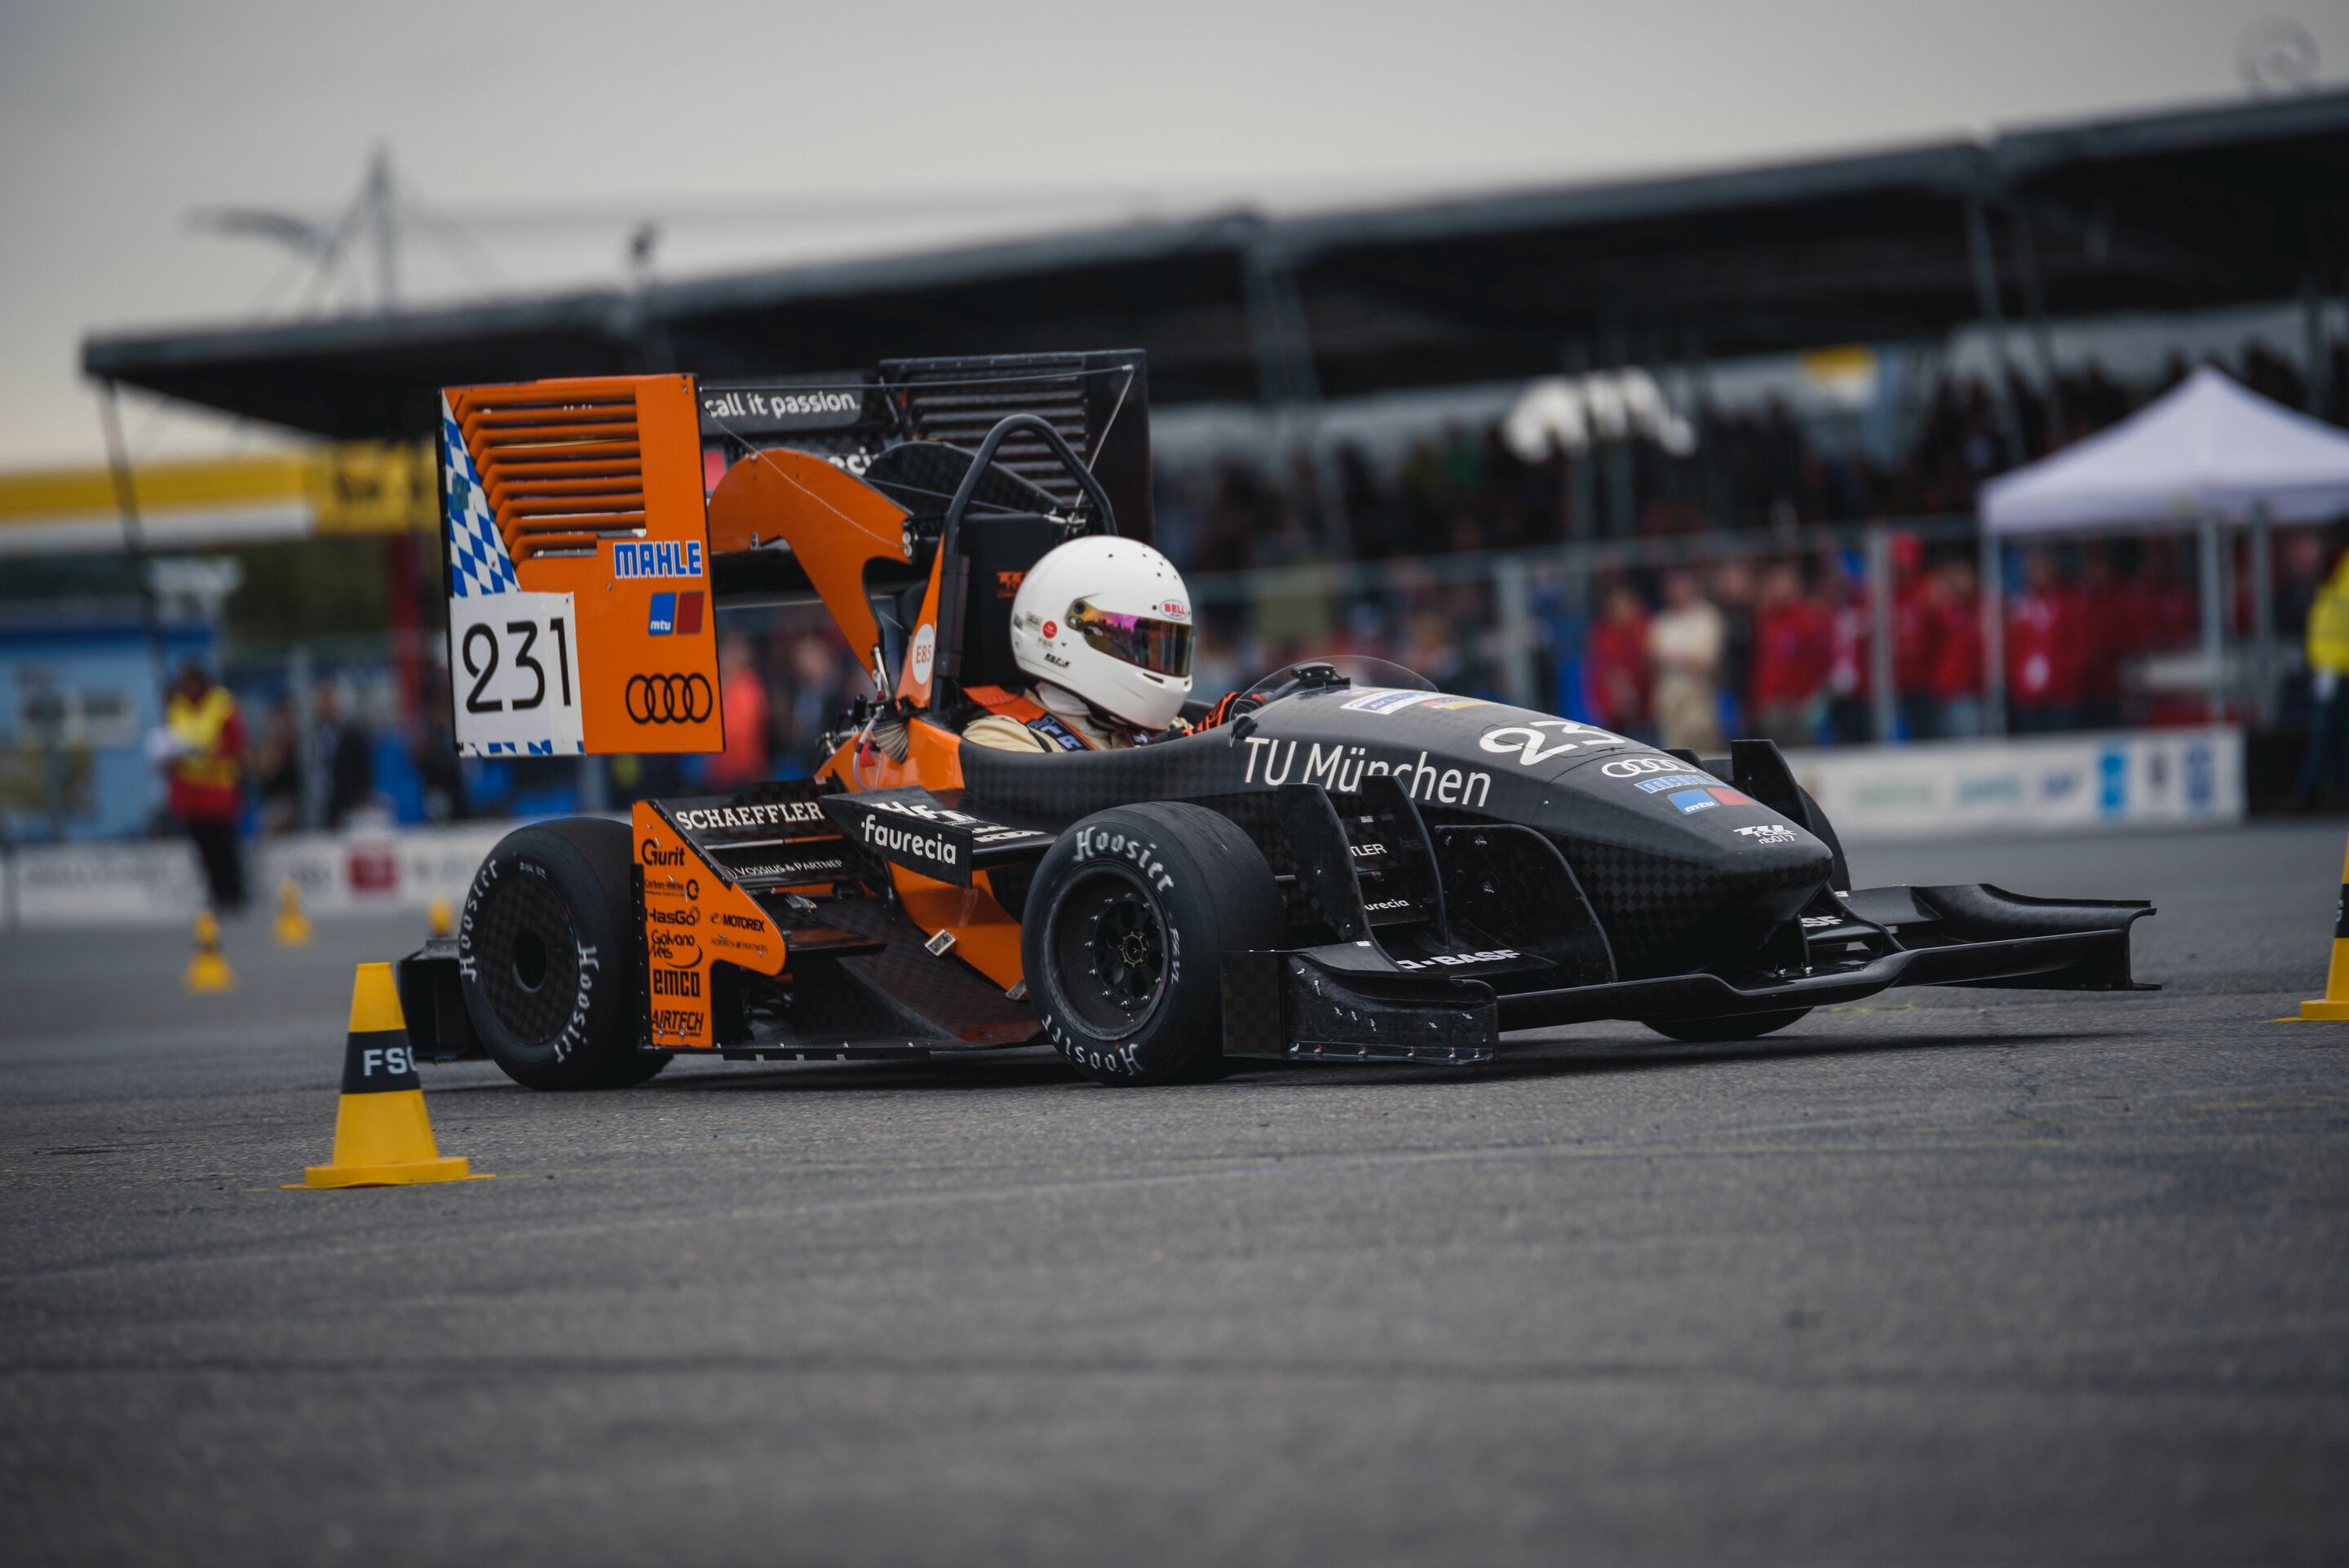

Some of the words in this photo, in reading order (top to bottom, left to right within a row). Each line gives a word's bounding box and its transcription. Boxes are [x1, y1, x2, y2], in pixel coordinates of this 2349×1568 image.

[704, 392, 746, 417] call
[746, 392, 768, 415] it
[770, 390, 861, 419] passion.
[613, 541, 703, 579] MAHLE
[1164, 603, 1186, 615] BELL
[650, 619, 672, 632] mtu
[462, 617, 573, 714] 231
[914, 642, 934, 666] E85
[1245, 736, 1298, 787] TU
[675, 802, 825, 830] SCHAEFFLER
[1683, 802, 1716, 813] mtu
[641, 838, 685, 868] Gurit
[862, 814, 957, 865] faurecia
[1072, 826, 1174, 892] Hoosier
[722, 913, 766, 933] MOTOREX
[1430, 949, 1521, 965] BASF
[653, 969, 701, 998] emco
[554, 940, 600, 1065] Hoosier
[652, 1009, 704, 1031] AIRTECH
